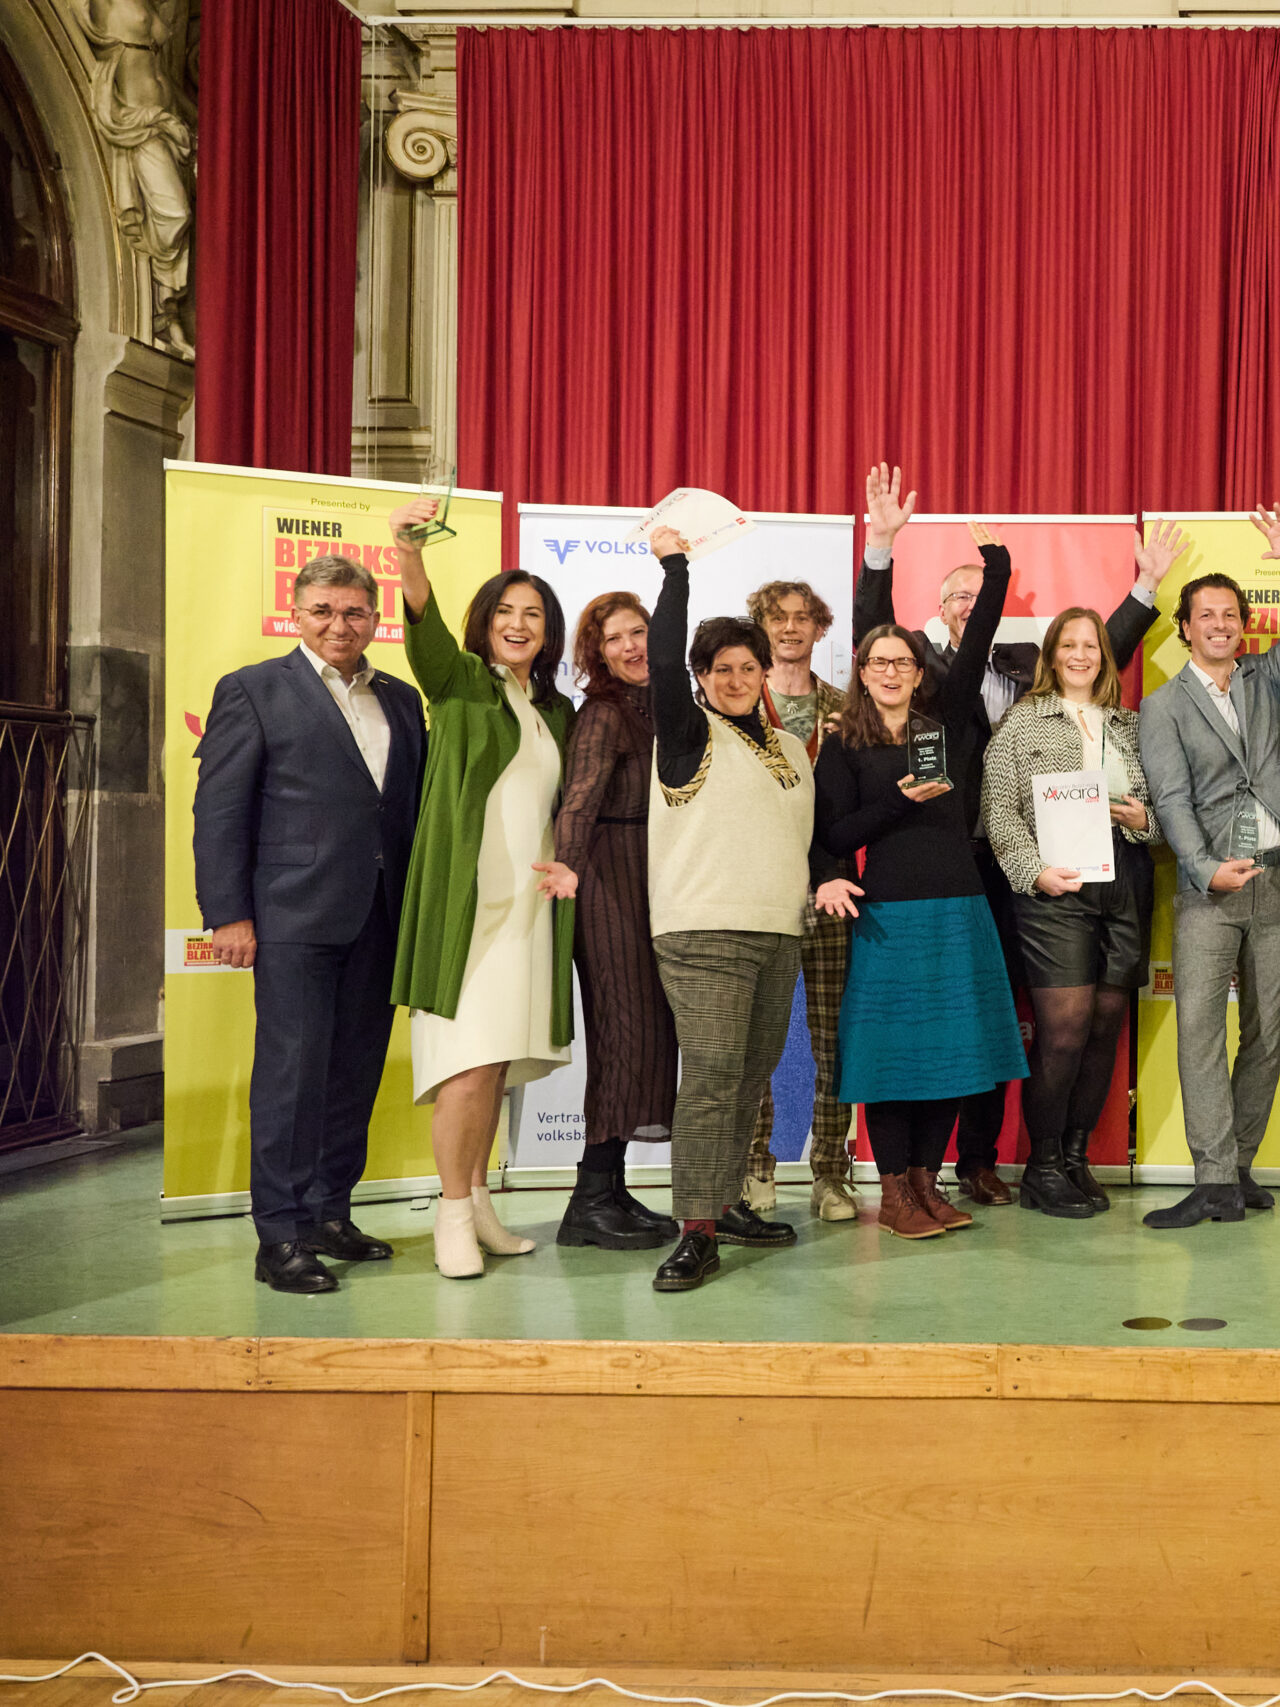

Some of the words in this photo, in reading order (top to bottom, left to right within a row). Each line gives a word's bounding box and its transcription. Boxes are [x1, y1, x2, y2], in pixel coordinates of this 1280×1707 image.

[311, 498, 357, 510] Presented
[359, 502, 371, 511] by
[276, 517, 343, 538] WIENER
[585, 540, 655, 555] VOLKS
[1243, 589, 1280, 604] ENER
[1042, 783, 1100, 802] Award
[187, 950, 214, 960] BLAT
[1154, 980, 1174, 989] BLAT
[537, 1112, 587, 1123] Vertrau
[537, 1129, 587, 1141] volksba
